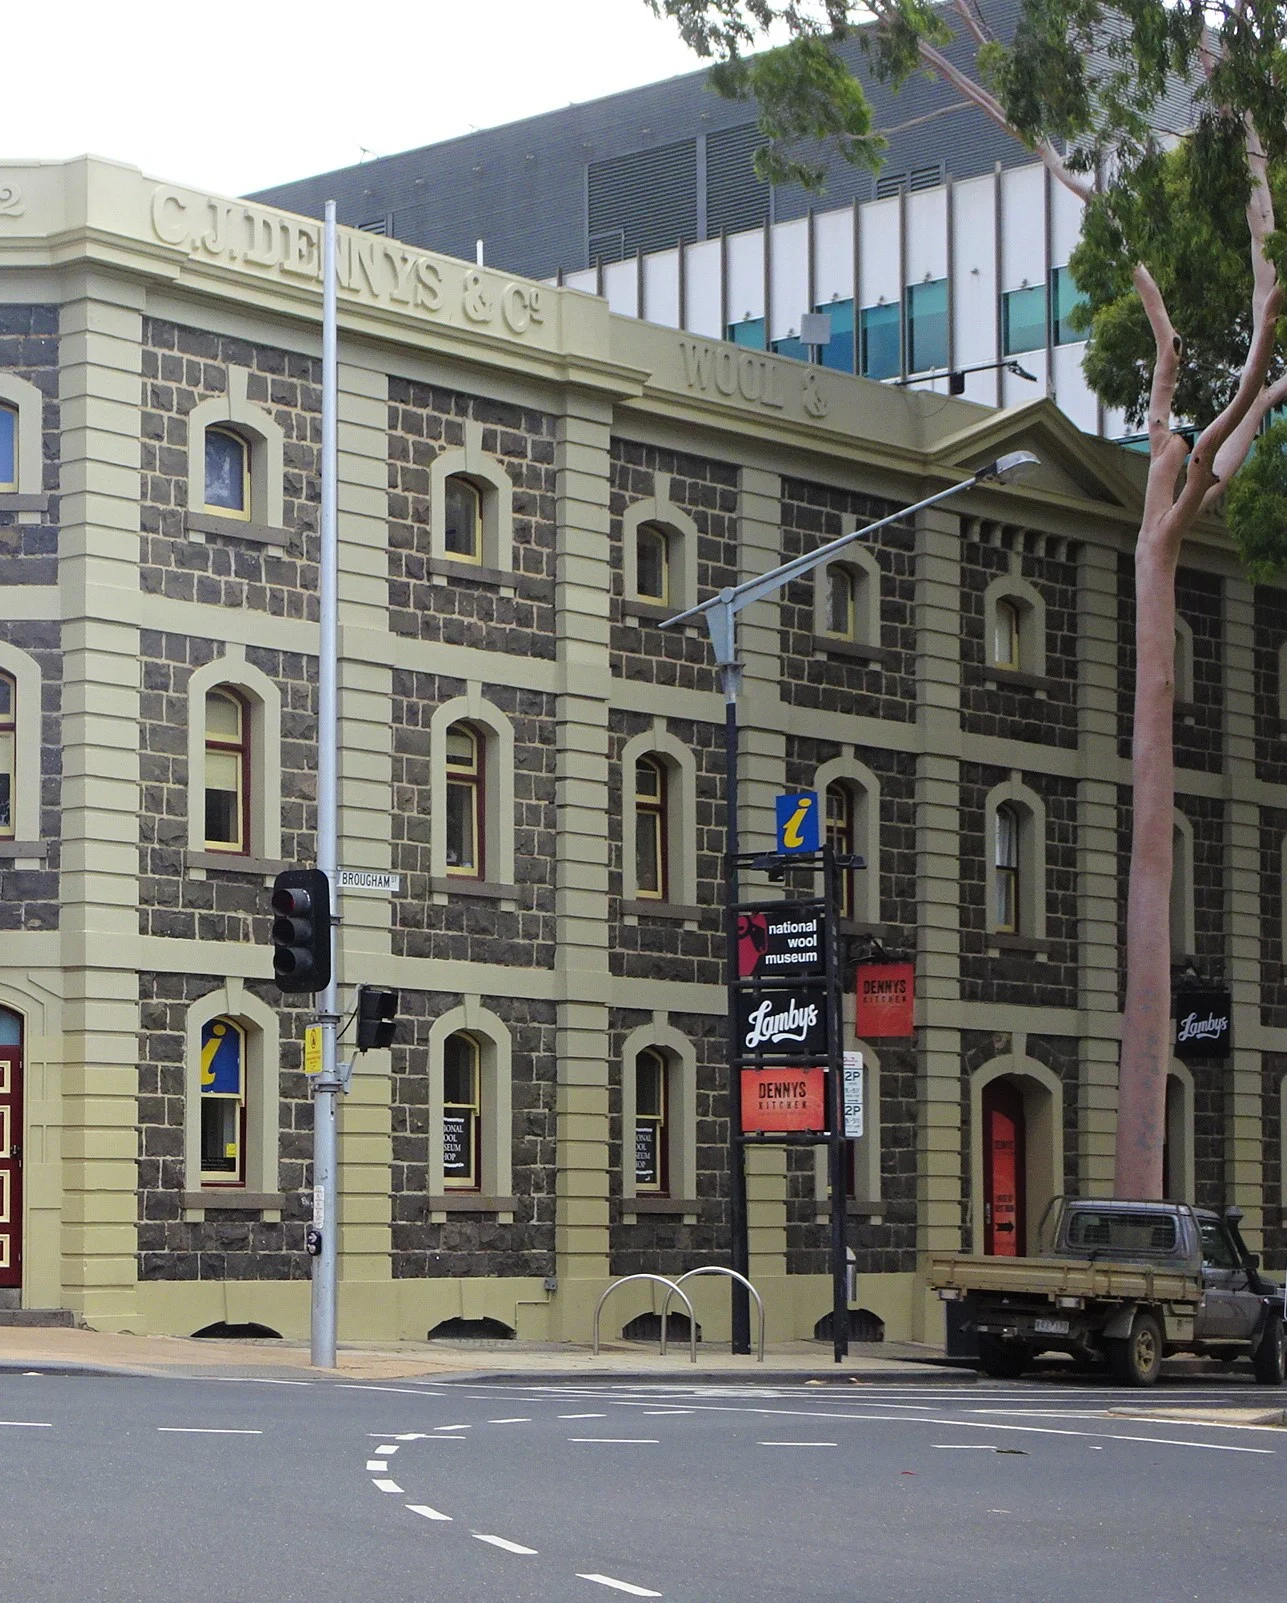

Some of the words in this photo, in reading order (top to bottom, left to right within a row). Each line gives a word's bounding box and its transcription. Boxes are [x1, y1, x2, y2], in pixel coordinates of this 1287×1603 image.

[463, 267, 492, 323] &
[679, 343, 784, 410] WOOL
[801, 368, 831, 419] &
[342, 872, 390, 888] BROUGHAM
[768, 919, 817, 936] national
[788, 934, 817, 948] wool
[765, 950, 818, 966] museum
[863, 980, 907, 994] DENNYS
[745, 998, 819, 1048] Lambys
[1178, 1012, 1228, 1041] Lambys
[844, 1071, 861, 1081] 2P
[758, 1081, 807, 1099] DENNYS
[758, 1101, 808, 1110] KITCHEN
[844, 1105, 861, 1116] 2P
